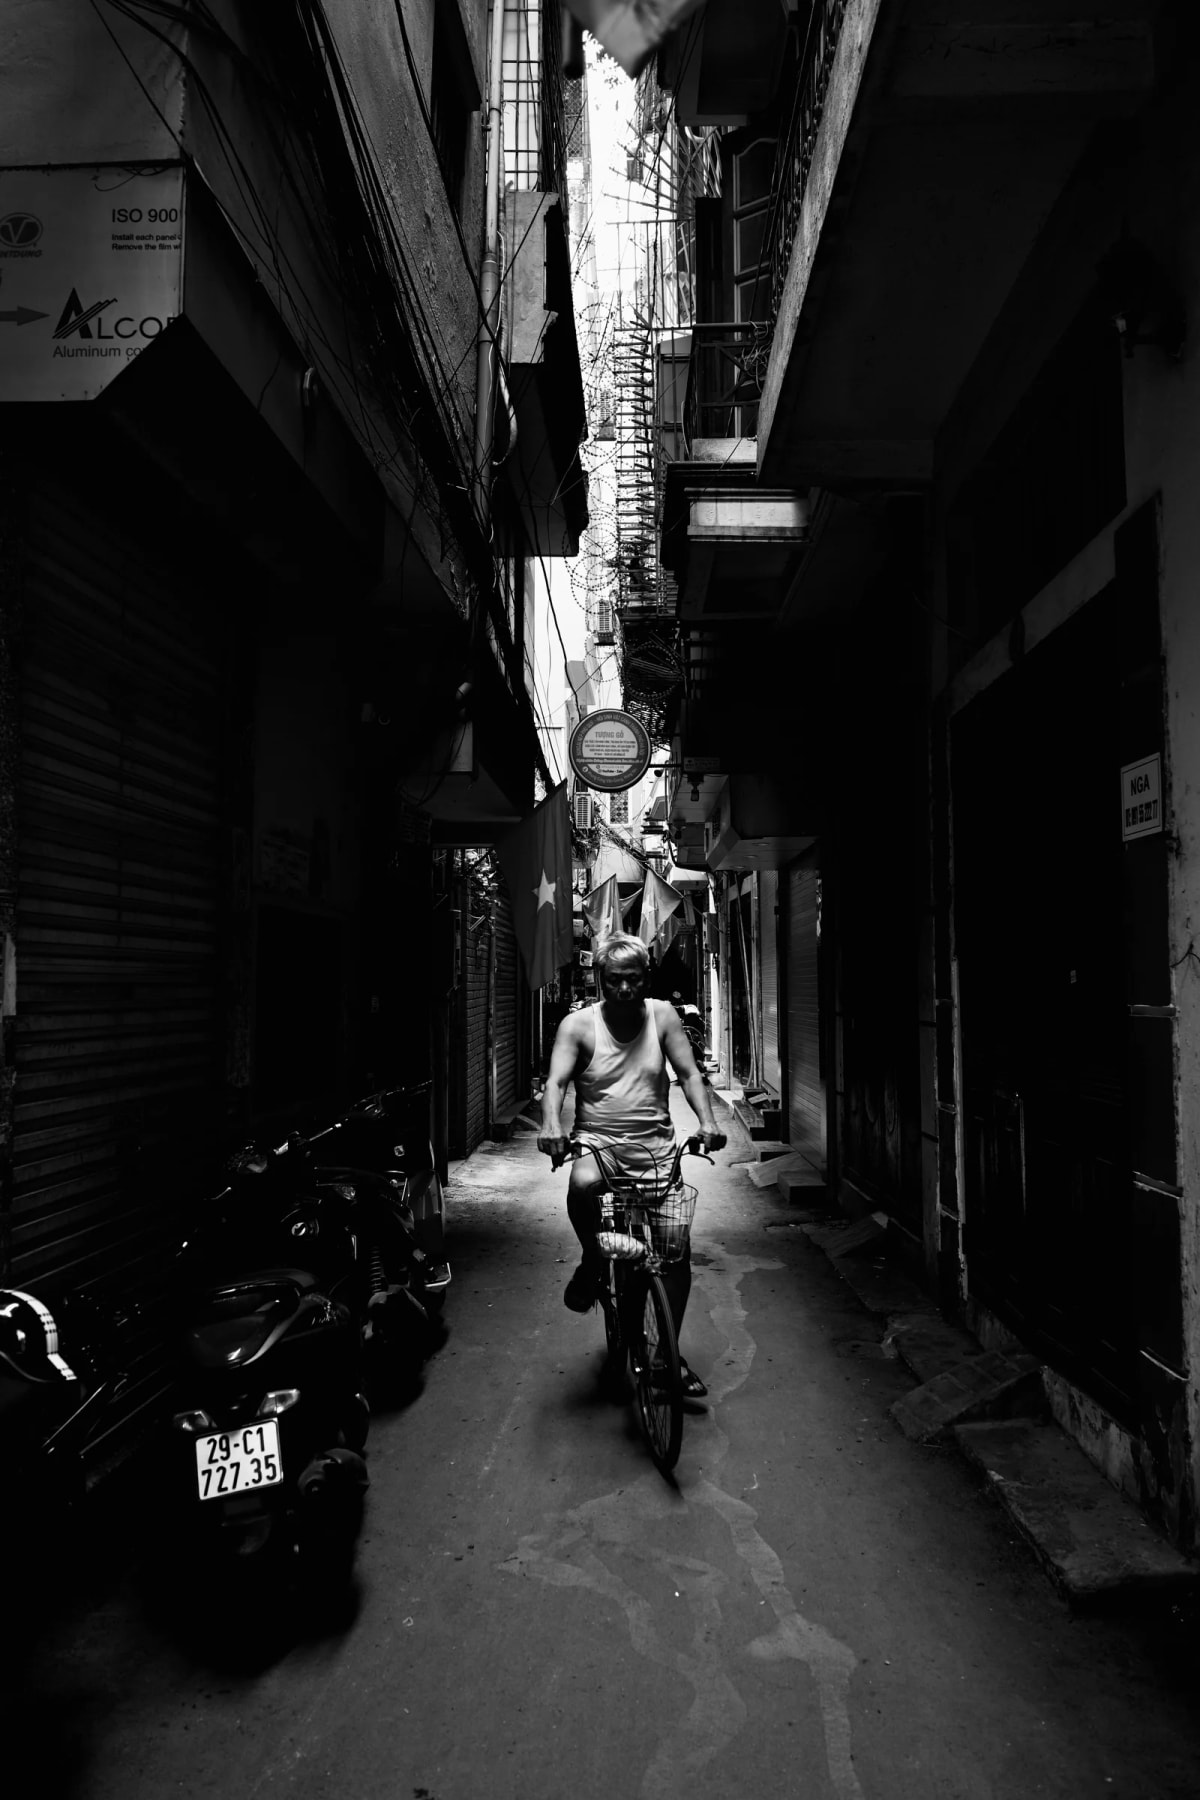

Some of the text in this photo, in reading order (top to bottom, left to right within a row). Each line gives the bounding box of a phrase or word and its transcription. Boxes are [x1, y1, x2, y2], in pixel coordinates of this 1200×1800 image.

[112, 208, 142, 223] ISO
[156, 234, 177, 243] panel
[53, 345, 121, 358] Aluminum
[1131, 774, 1150, 796] NGA
[207, 1426, 265, 1465] 29-C1
[201, 1454, 277, 1497] 727.35
